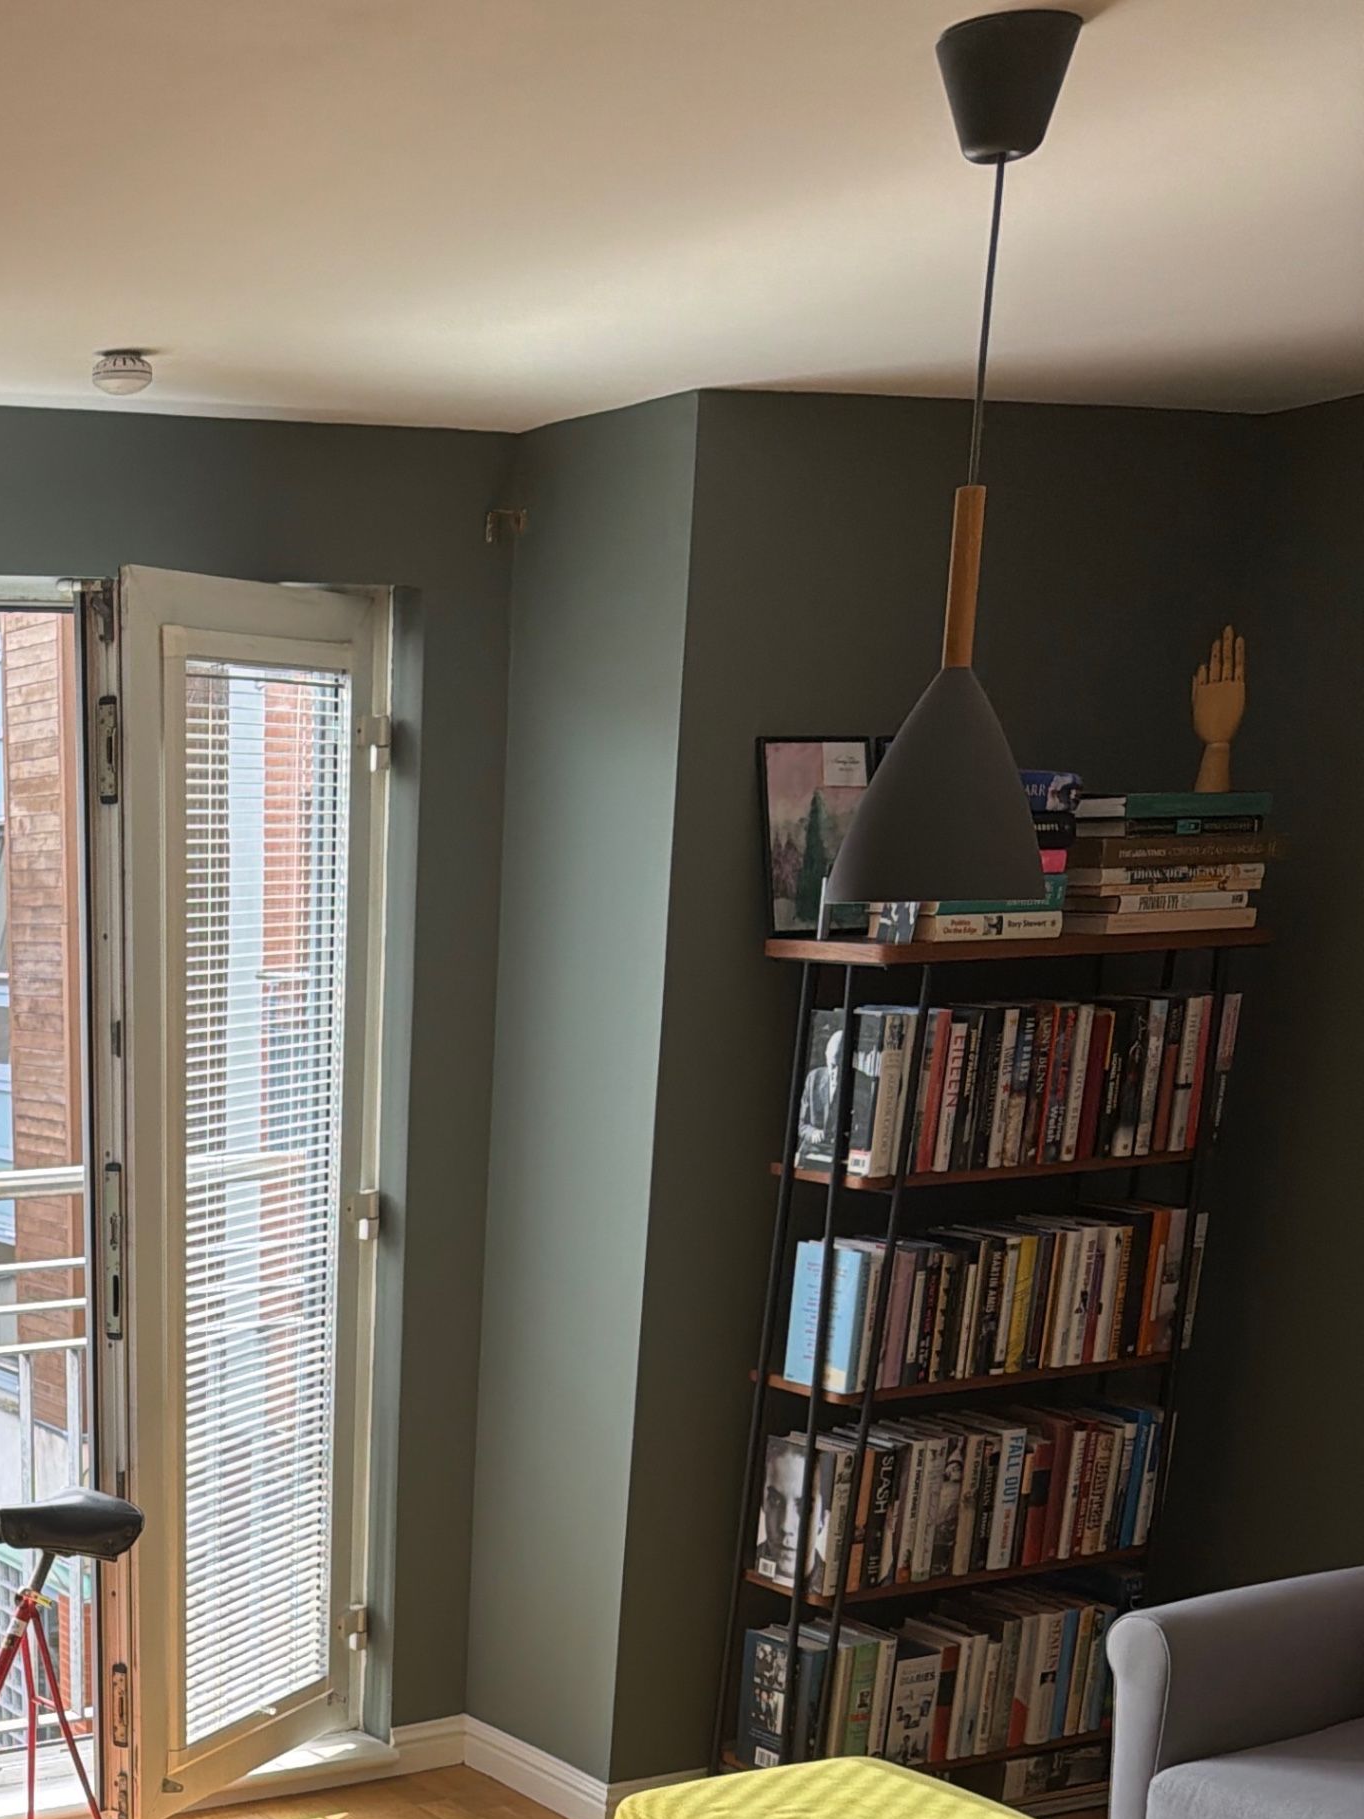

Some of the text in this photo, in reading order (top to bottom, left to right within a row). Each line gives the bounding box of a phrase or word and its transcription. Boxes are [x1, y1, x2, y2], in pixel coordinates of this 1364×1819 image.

[1008, 920, 1021, 928] Rory
[1138, 895, 1166, 910] PRIVATE
[947, 1035, 964, 1108] EILEEN
[1019, 1046, 1032, 1082] BANKS
[1036, 1016, 1052, 1093] TONY BENN
[1046, 1105, 1059, 1143] Welsh
[1055, 1105, 1065, 1142] Irvine
[986, 1251, 1002, 1313] MARTIN AMIS
[873, 1455, 895, 1514] SLASH
[910, 1470, 921, 1520] MORTIMER
[1002, 1436, 1024, 1505] FALL OUT
